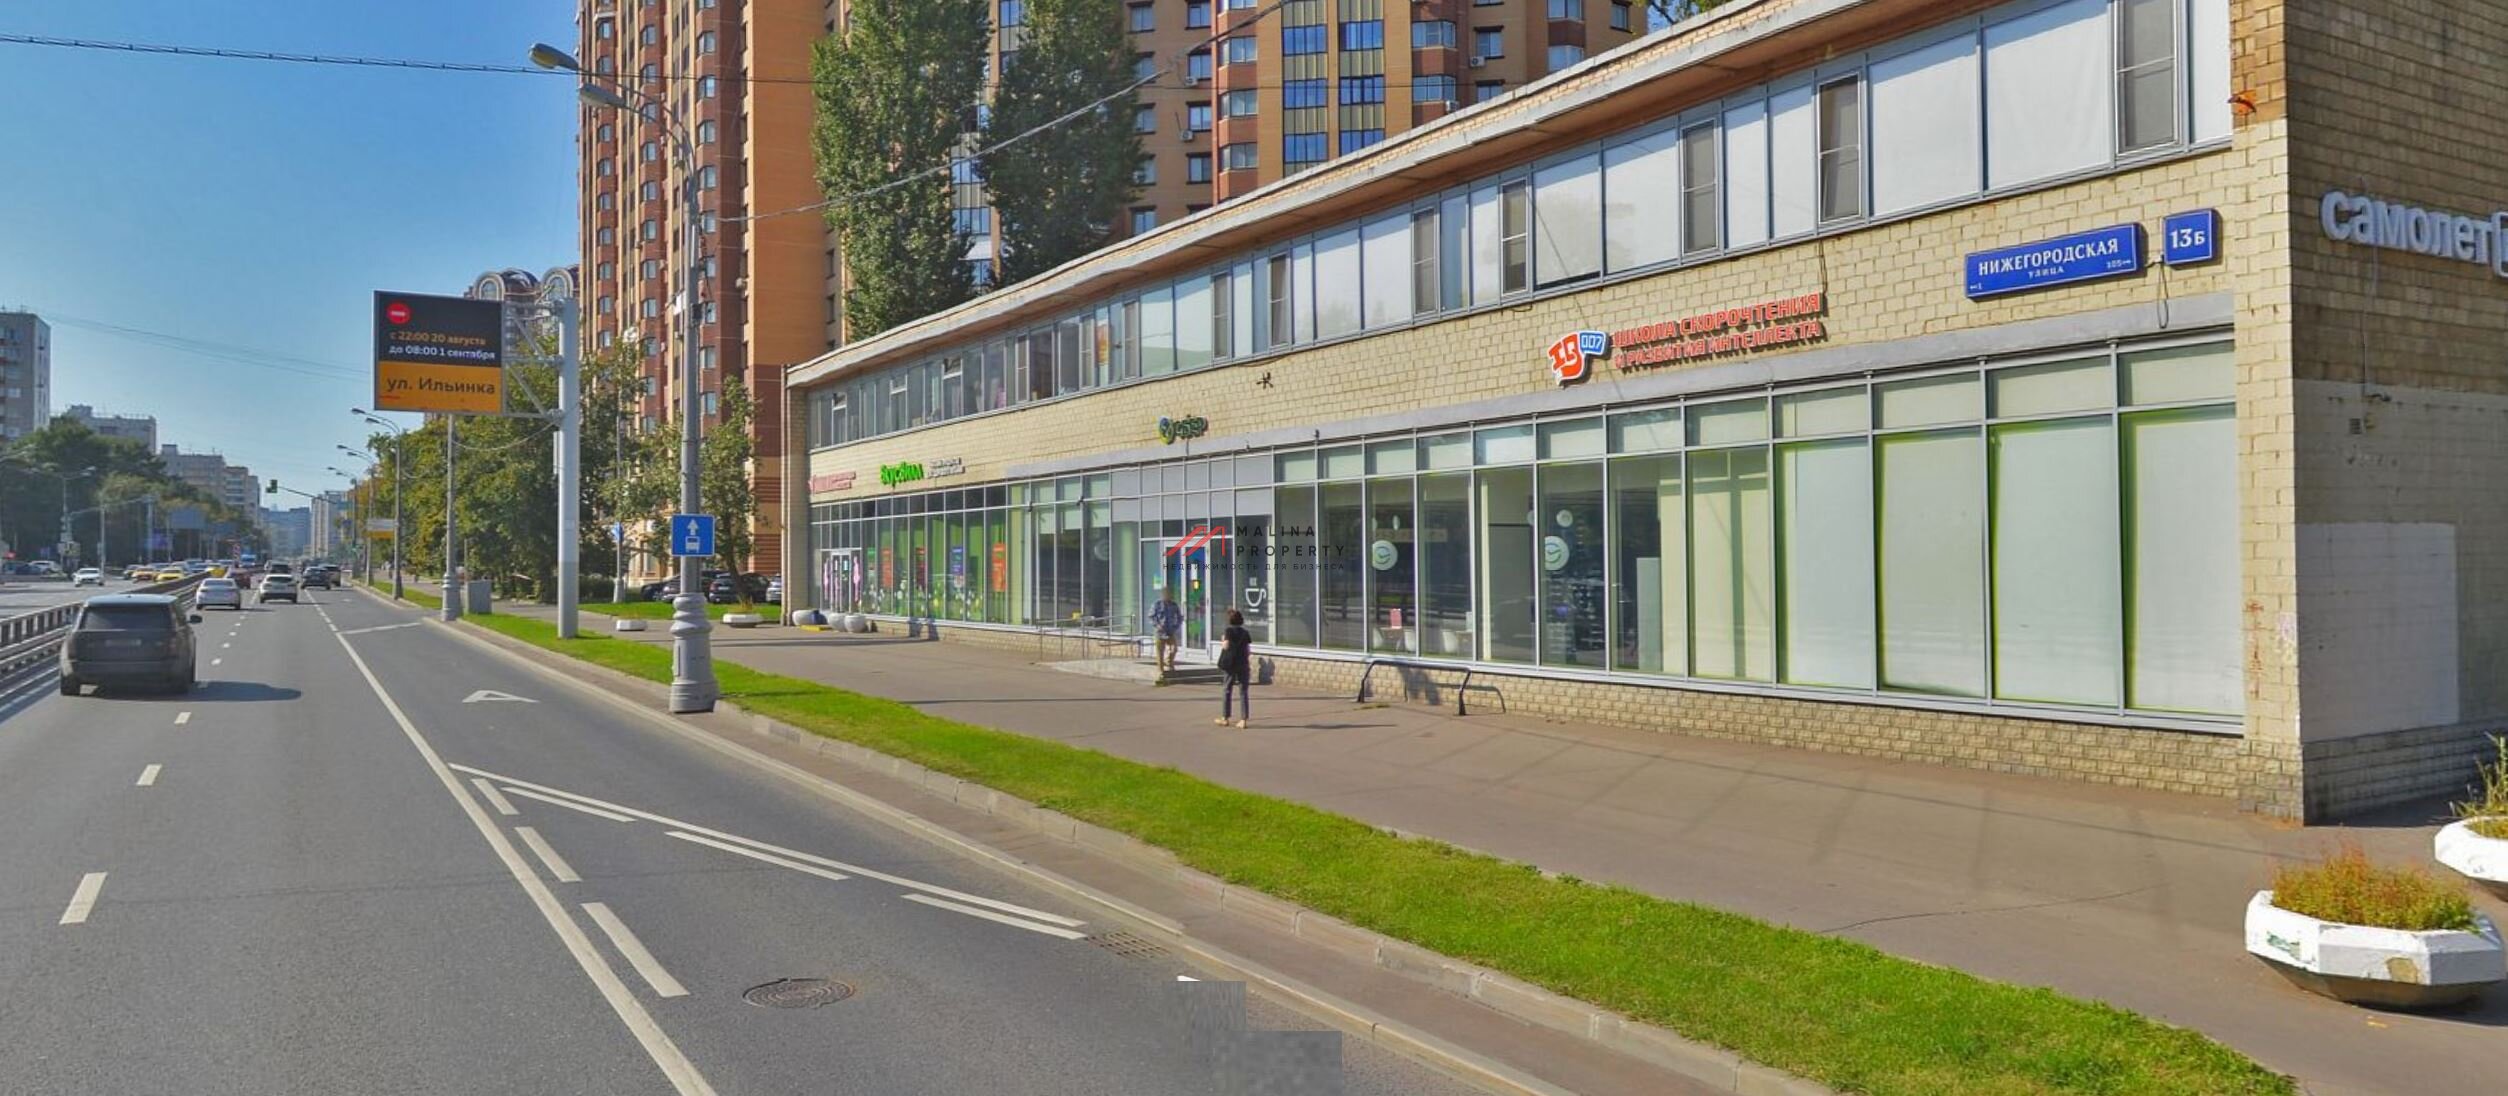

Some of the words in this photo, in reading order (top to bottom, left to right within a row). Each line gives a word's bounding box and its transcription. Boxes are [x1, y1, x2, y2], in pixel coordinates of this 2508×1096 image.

[1978, 237, 2119, 277] НИЖЕГОРОДСКАЯ
[2028, 266, 2065, 279] УЛИЦА
[1613, 320, 1676, 349] ШКОЛА
[1679, 292, 1821, 335] СКОРОЧТЕНИЯ
[398, 331, 430, 341] 22:00
[431, 333, 447, 343] 20
[1614, 353, 1625, 369] И
[1628, 338, 1706, 367] РАЗВИТИЯ
[1708, 320, 1821, 354] ИНТЕЛЛЕКТА
[389, 345, 403, 355] до
[405, 345, 438, 356] 08:00
[447, 349, 496, 361] сентября
[387, 377, 413, 393] ул.
[418, 376, 496, 395] Ильинка
